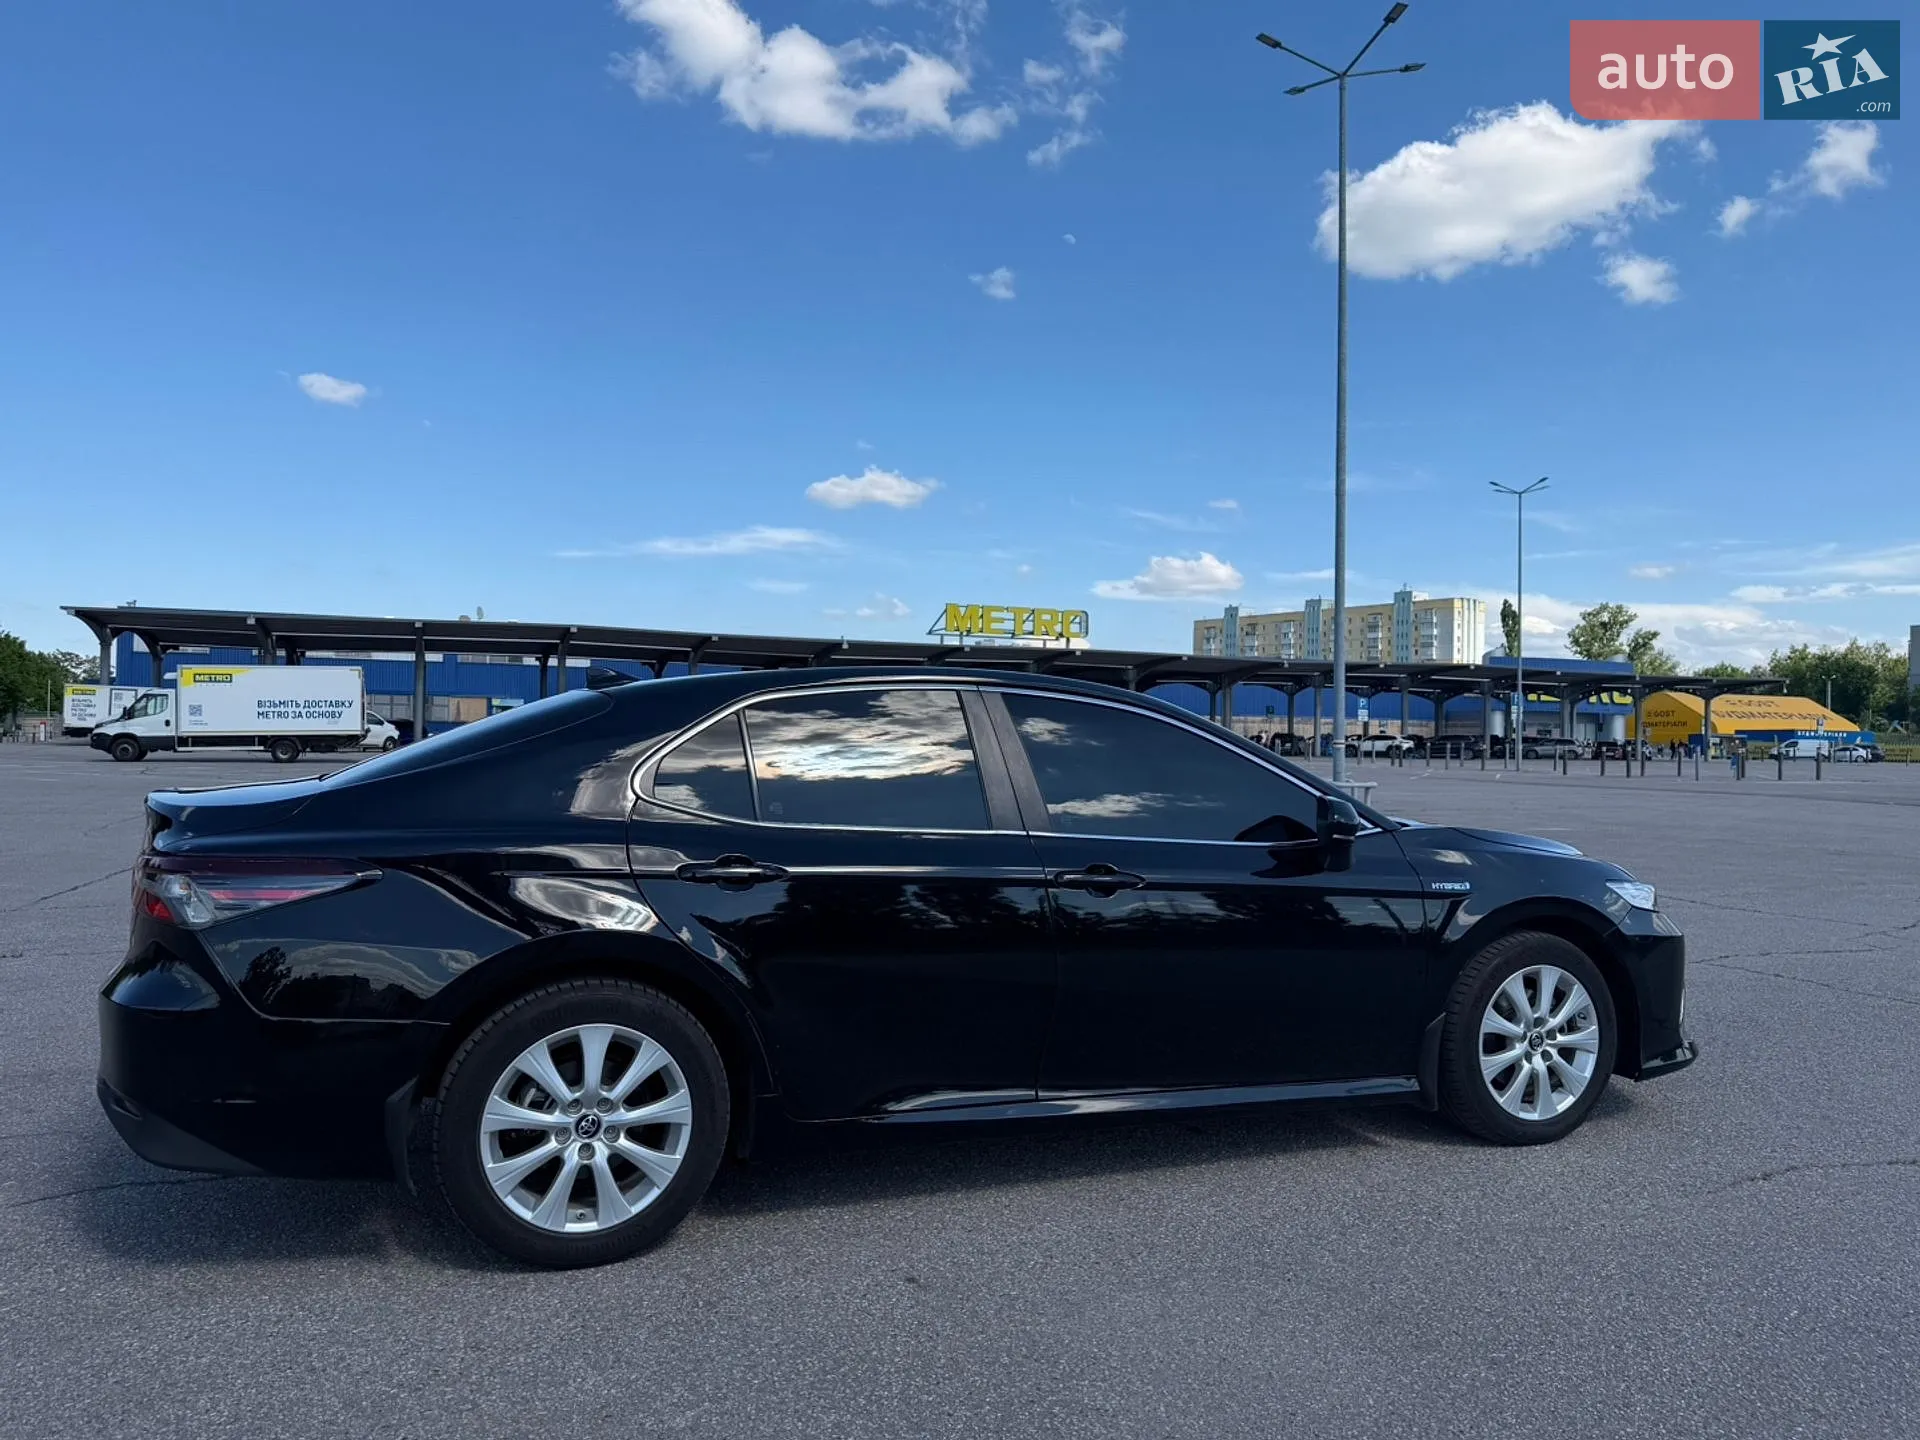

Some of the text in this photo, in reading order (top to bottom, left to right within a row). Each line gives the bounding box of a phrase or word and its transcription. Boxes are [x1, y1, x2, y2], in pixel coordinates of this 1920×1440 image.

[945, 603, 1089, 638] METRO
[195, 674, 231, 682] METRO
[257, 700, 354, 710] ВІЗЬМІТЬ ДОСТАВКУ
[257, 711, 343, 720] METRO ЗА ОСНОВУ
